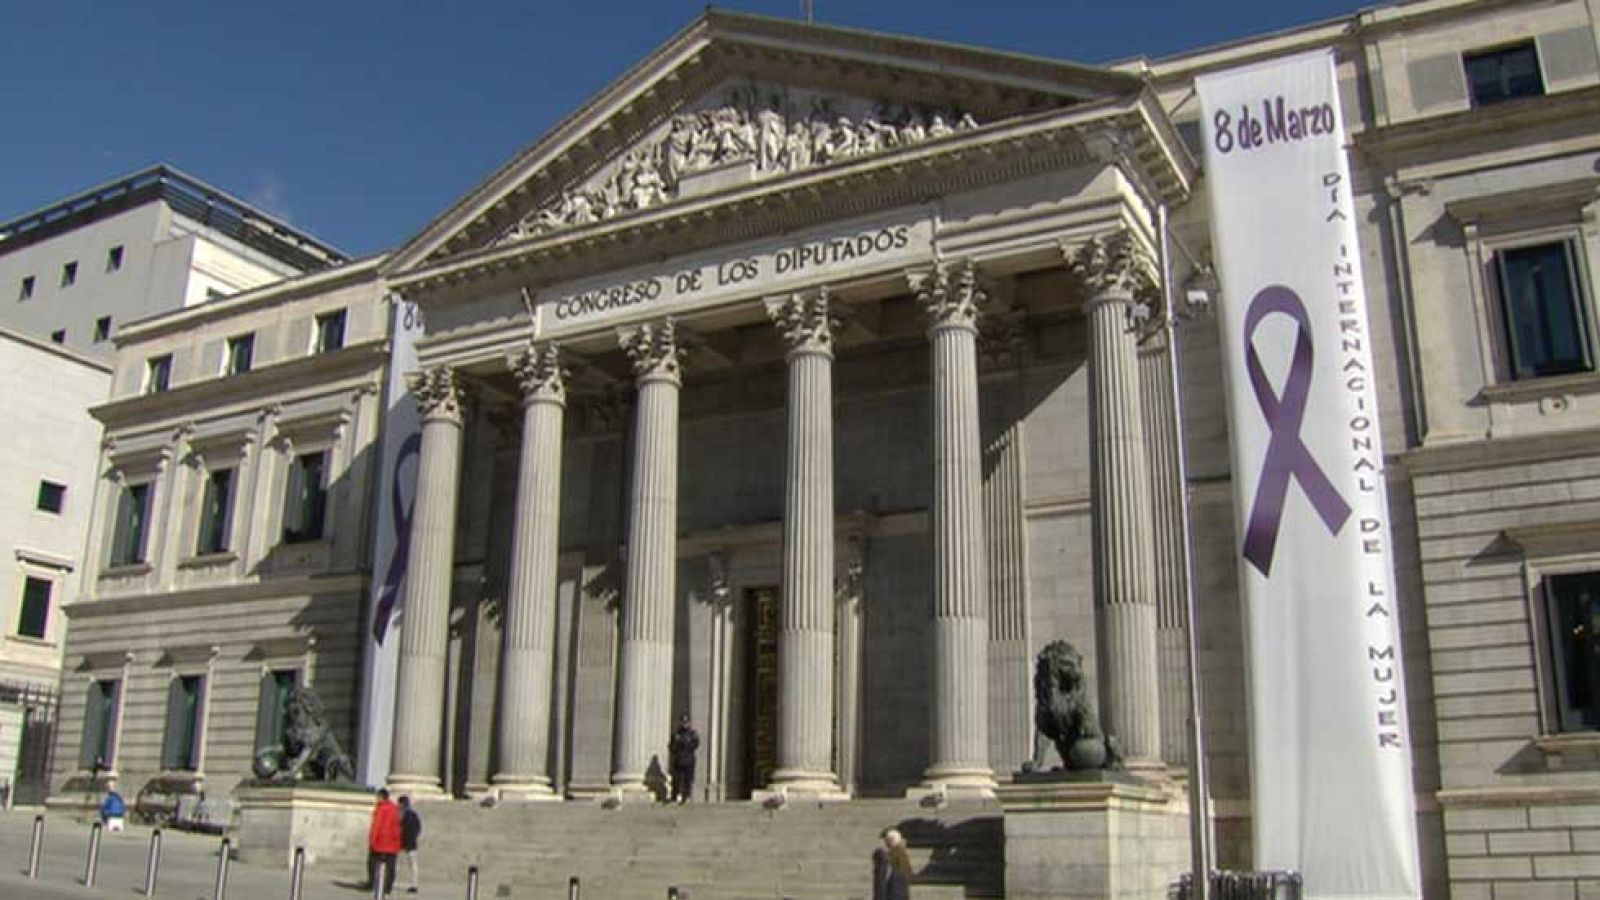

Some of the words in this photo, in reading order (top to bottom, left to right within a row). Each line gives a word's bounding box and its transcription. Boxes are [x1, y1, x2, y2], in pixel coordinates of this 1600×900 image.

[1213, 108, 1233, 153] 8
[1237, 105, 1263, 150] de
[1263, 96, 1335, 144] Marzo
[555, 280, 662, 320] CONGRESO
[676, 268, 702, 295] DE
[717, 257, 760, 287] LOS
[775, 226, 909, 274] DIPUTADOS
[1333, 244, 1376, 491] INTERNACIONAL
[1360, 518, 1382, 554] DE
[1366, 581, 1389, 617] LA
[1368, 646, 1401, 748] MUJER
